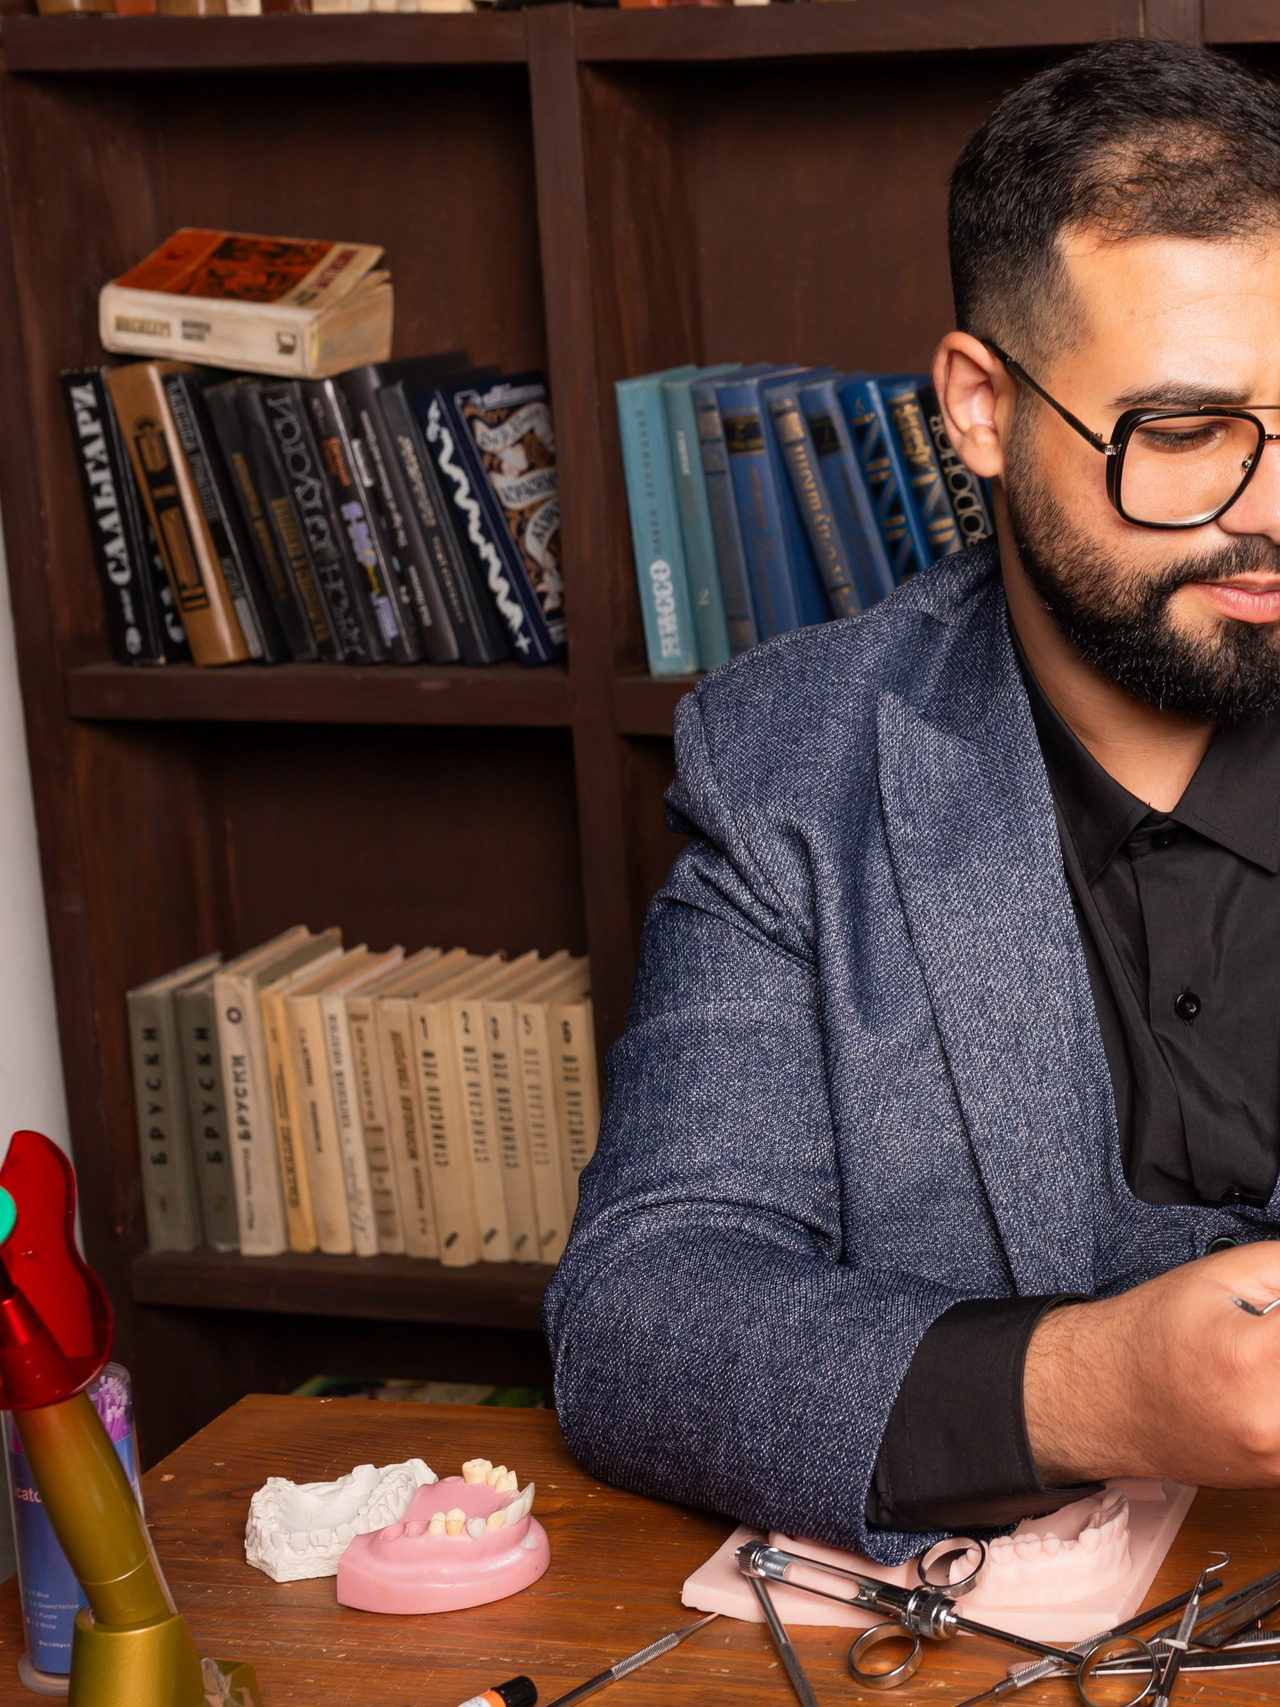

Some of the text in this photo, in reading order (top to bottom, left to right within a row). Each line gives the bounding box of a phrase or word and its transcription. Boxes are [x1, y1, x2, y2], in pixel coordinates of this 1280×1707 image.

[69, 382, 133, 587] САЛЬГАРИ
[420, 1016, 428, 1039] 1
[461, 1010, 470, 1034] 2
[142, 1027, 168, 1166] БРУСКИ
[194, 1026, 222, 1164] БРУСКИ
[231, 1054, 252, 1142] БРУСКИ
[421, 1050, 449, 1167] СТАНИСЛАВ ЛЕМ
[462, 1045, 489, 1163] СТАНИСЛАВ ЛЕМ
[492, 1051, 520, 1168] СТАНИСЛАВ ЛЕМ
[523, 1047, 549, 1165] СТАНИСЛАВ ЛЕМ
